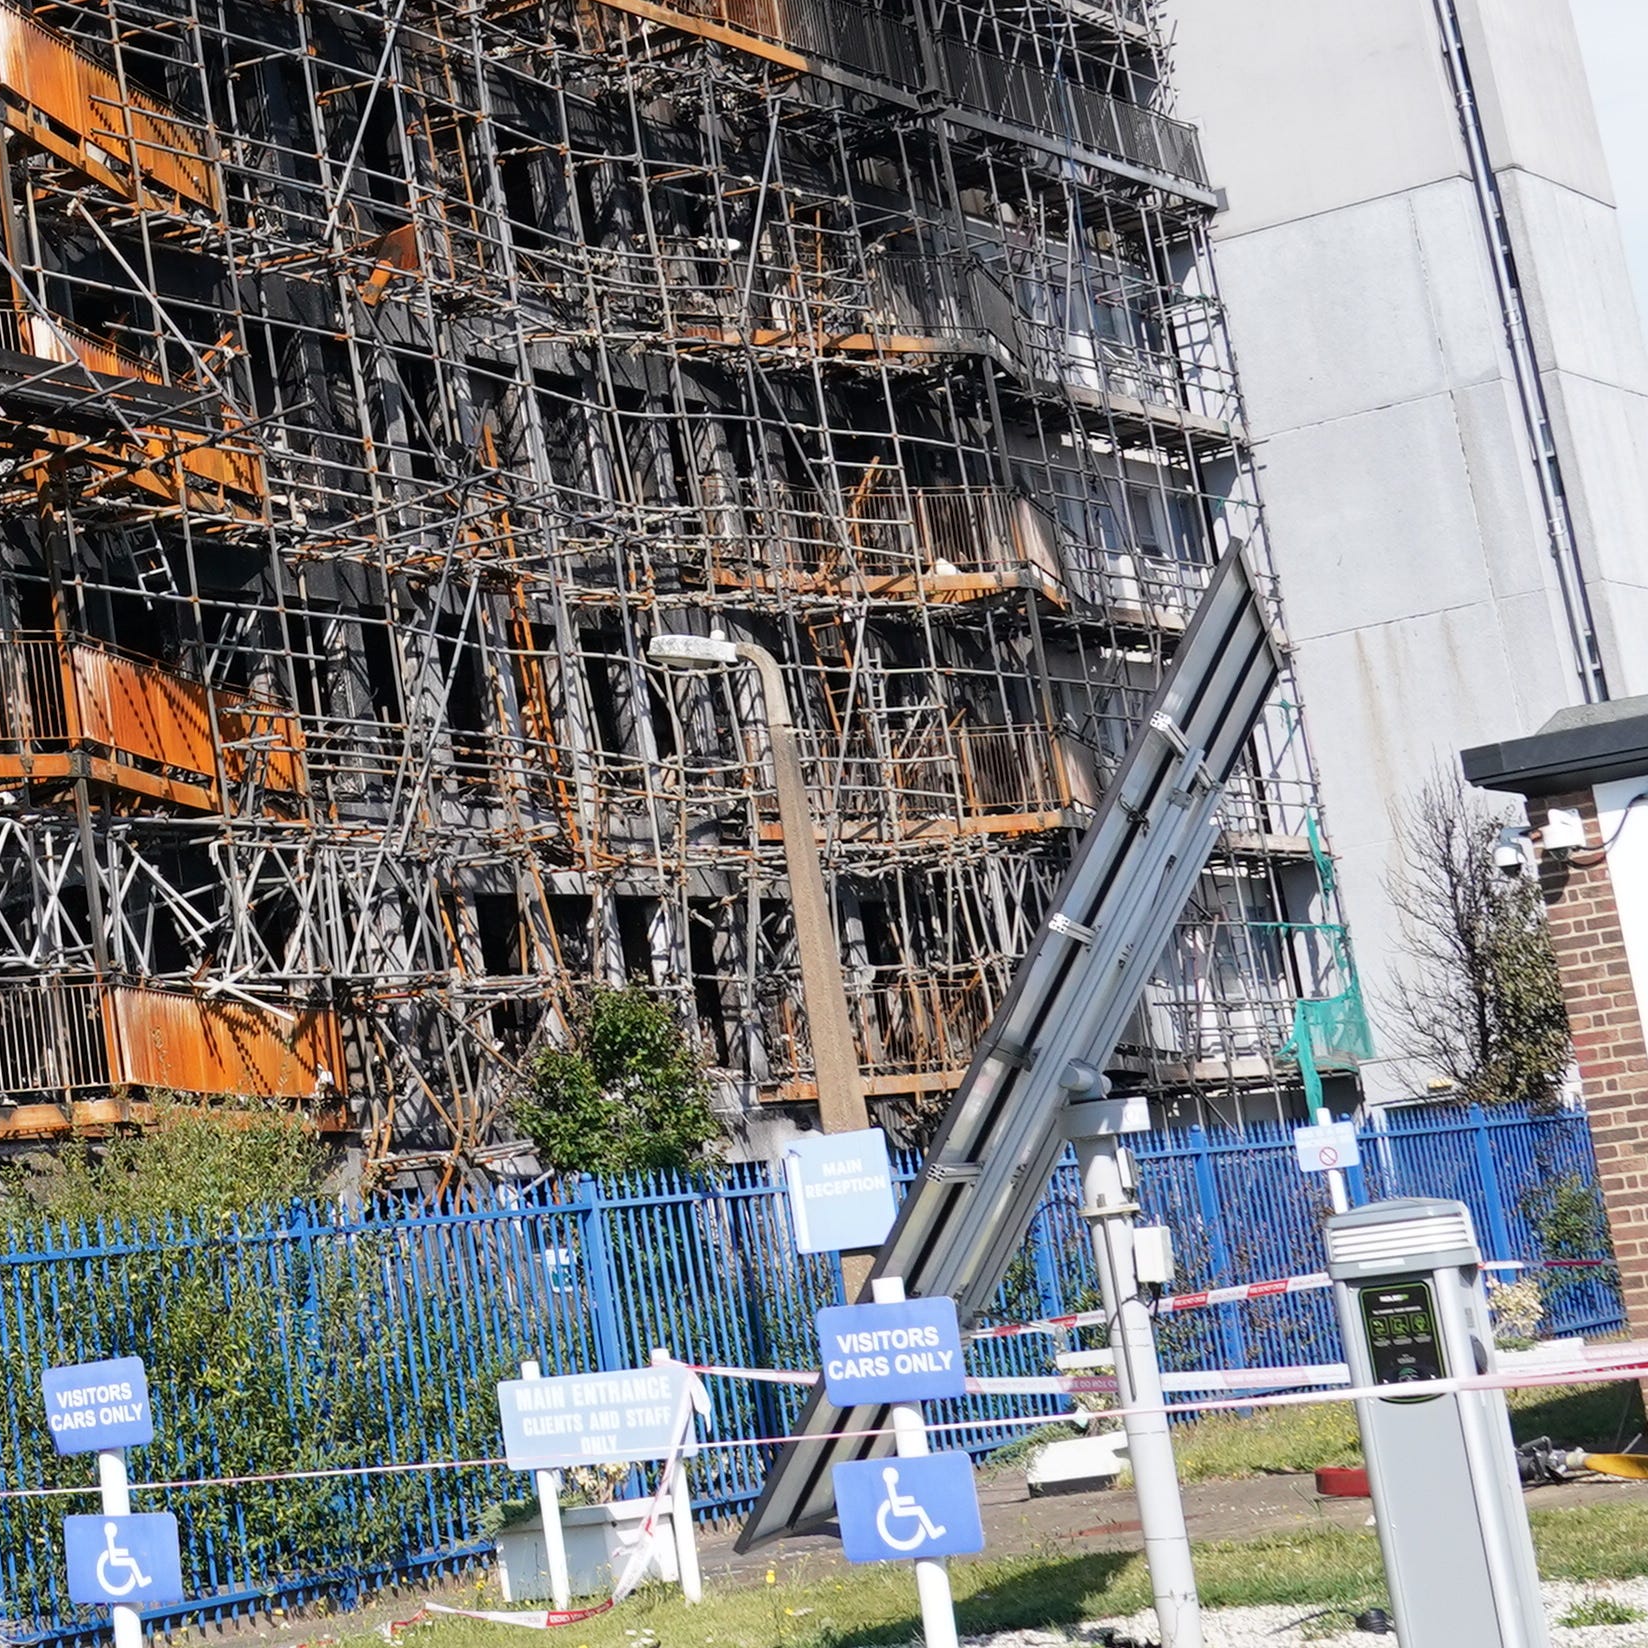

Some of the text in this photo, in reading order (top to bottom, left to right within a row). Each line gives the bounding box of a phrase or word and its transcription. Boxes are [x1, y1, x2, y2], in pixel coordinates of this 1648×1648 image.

[822, 1158, 863, 1177] MAIN
[805, 1175, 886, 1199] RECEPTION
[836, 1326, 940, 1354] VISITORS
[828, 1350, 953, 1380] CARS ONLY
[56, 1383, 132, 1408] VISITORS
[515, 1375, 672, 1411] MAIN ENTRANCE
[51, 1402, 142, 1431] CARS ONLY
[523, 1406, 671, 1436] CLIENTS AND STAFF
[580, 1434, 618, 1455] ONLY
